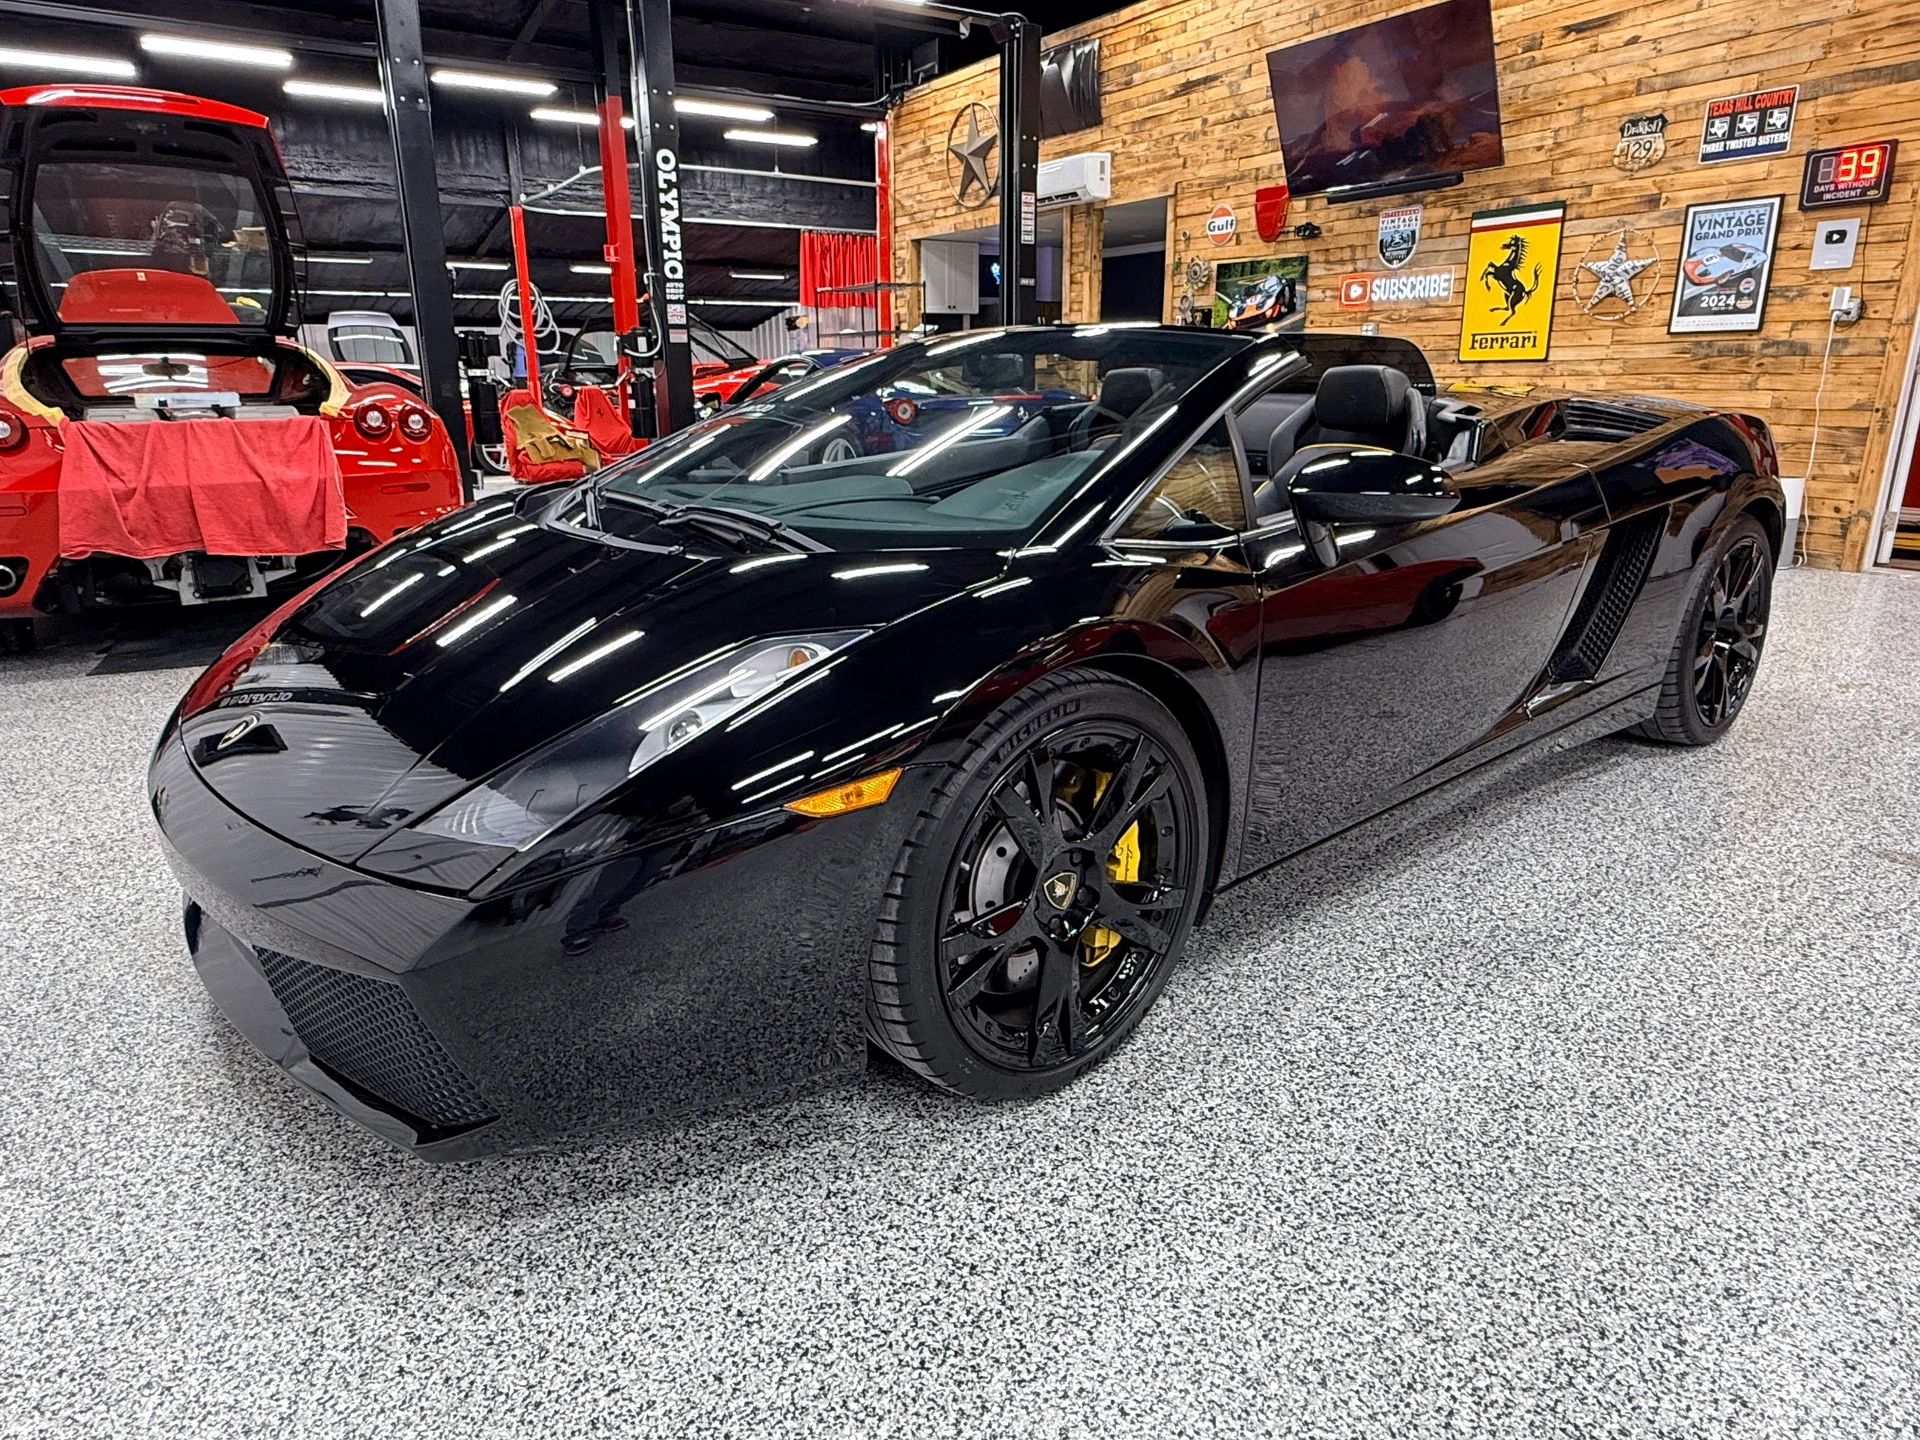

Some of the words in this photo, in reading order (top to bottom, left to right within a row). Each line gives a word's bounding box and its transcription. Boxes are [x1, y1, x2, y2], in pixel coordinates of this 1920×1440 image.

[1709, 100, 1734, 117] TEXAS
[1735, 96, 1753, 112] HILL
[1755, 89, 1795, 109] COUNTRY
[1625, 140, 1653, 161] 129
[1702, 141, 1725, 154] THREE
[1726, 137, 1757, 151] TWISTED
[1758, 132, 1789, 146] SISTERS
[1839, 149, 1880, 181] 39
[1813, 183, 1835, 193] DAYS
[1837, 179, 1876, 190] WITHOUT
[1823, 189, 1862, 201] INCIDENT
[656, 148, 684, 280] OLYMPIC
[1381, 215, 1419, 225] VINTAGE
[1698, 213, 1767, 231] VINTAGE
[1207, 218, 1235, 234] Gulf
[1695, 230, 1735, 241] GRAND
[1737, 226, 1765, 238] PRIX
[1371, 273, 1450, 302] SUBSCRIBE
[1700, 295, 1736, 308] 2024
[1469, 330, 1538, 350] Ferrari
[997, 698, 1081, 764] MICHELIN
